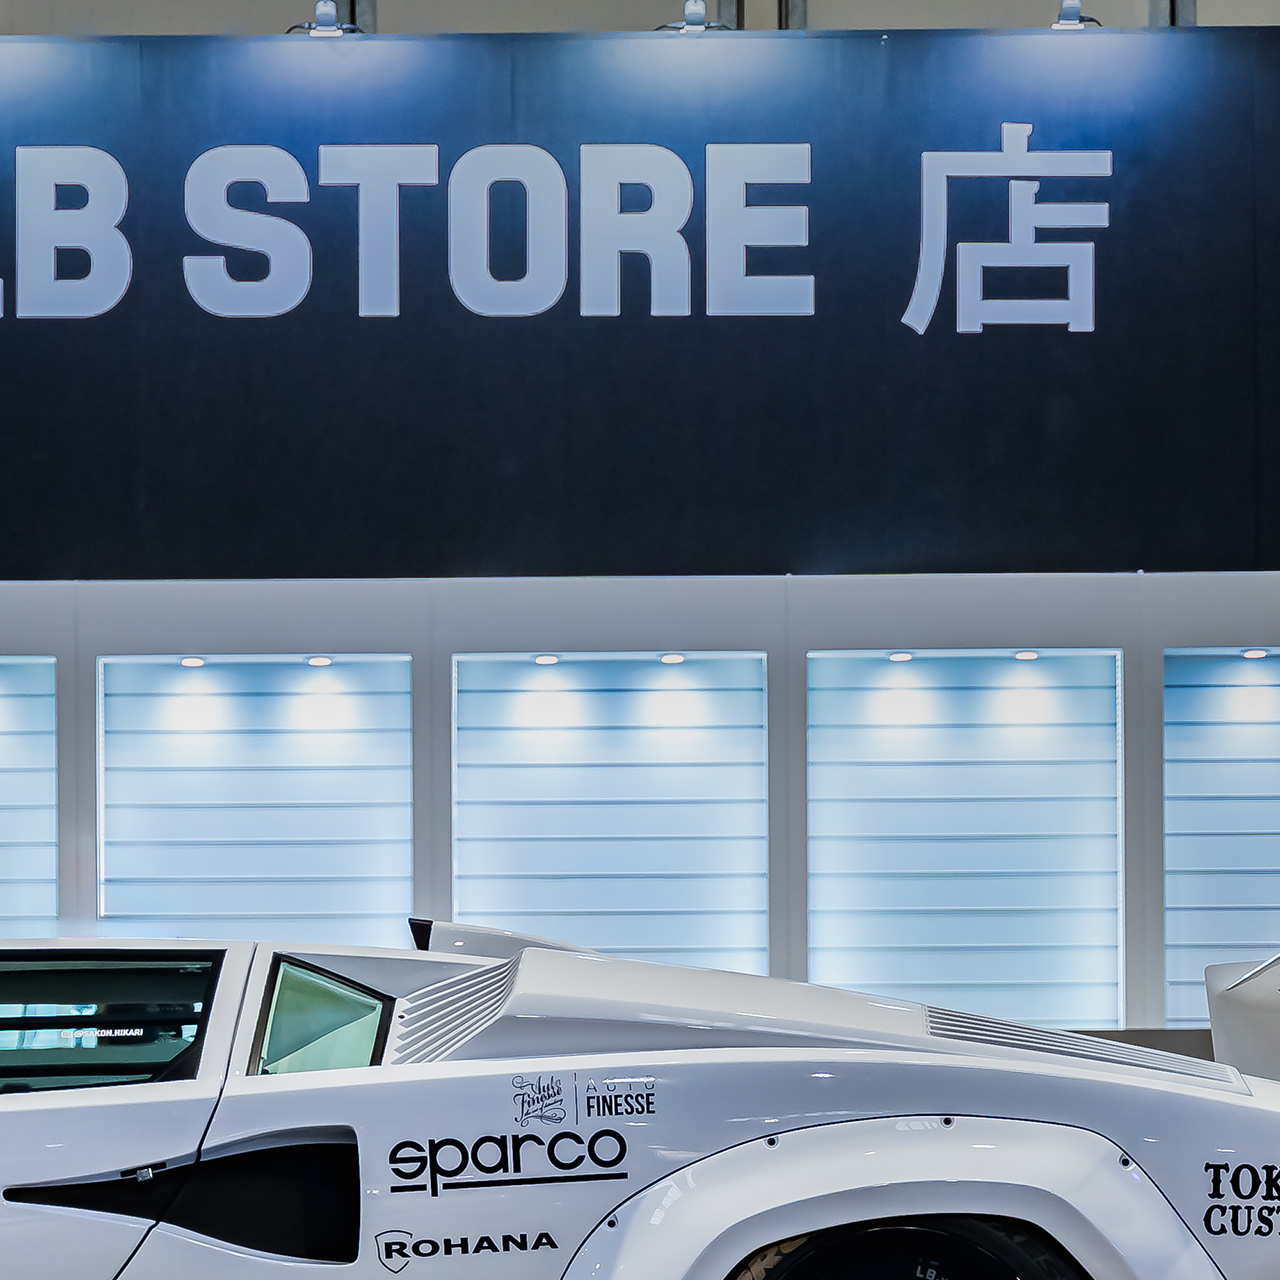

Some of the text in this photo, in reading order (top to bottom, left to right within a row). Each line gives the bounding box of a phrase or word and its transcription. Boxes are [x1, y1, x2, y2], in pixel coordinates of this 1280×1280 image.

[183, 143, 815, 317] STORE
[901, 122, 1112, 334] 店
[586, 1092, 656, 1118] FINESSE
[389, 1129, 628, 1197] sparco
[383, 1231, 559, 1260] ROHANA
